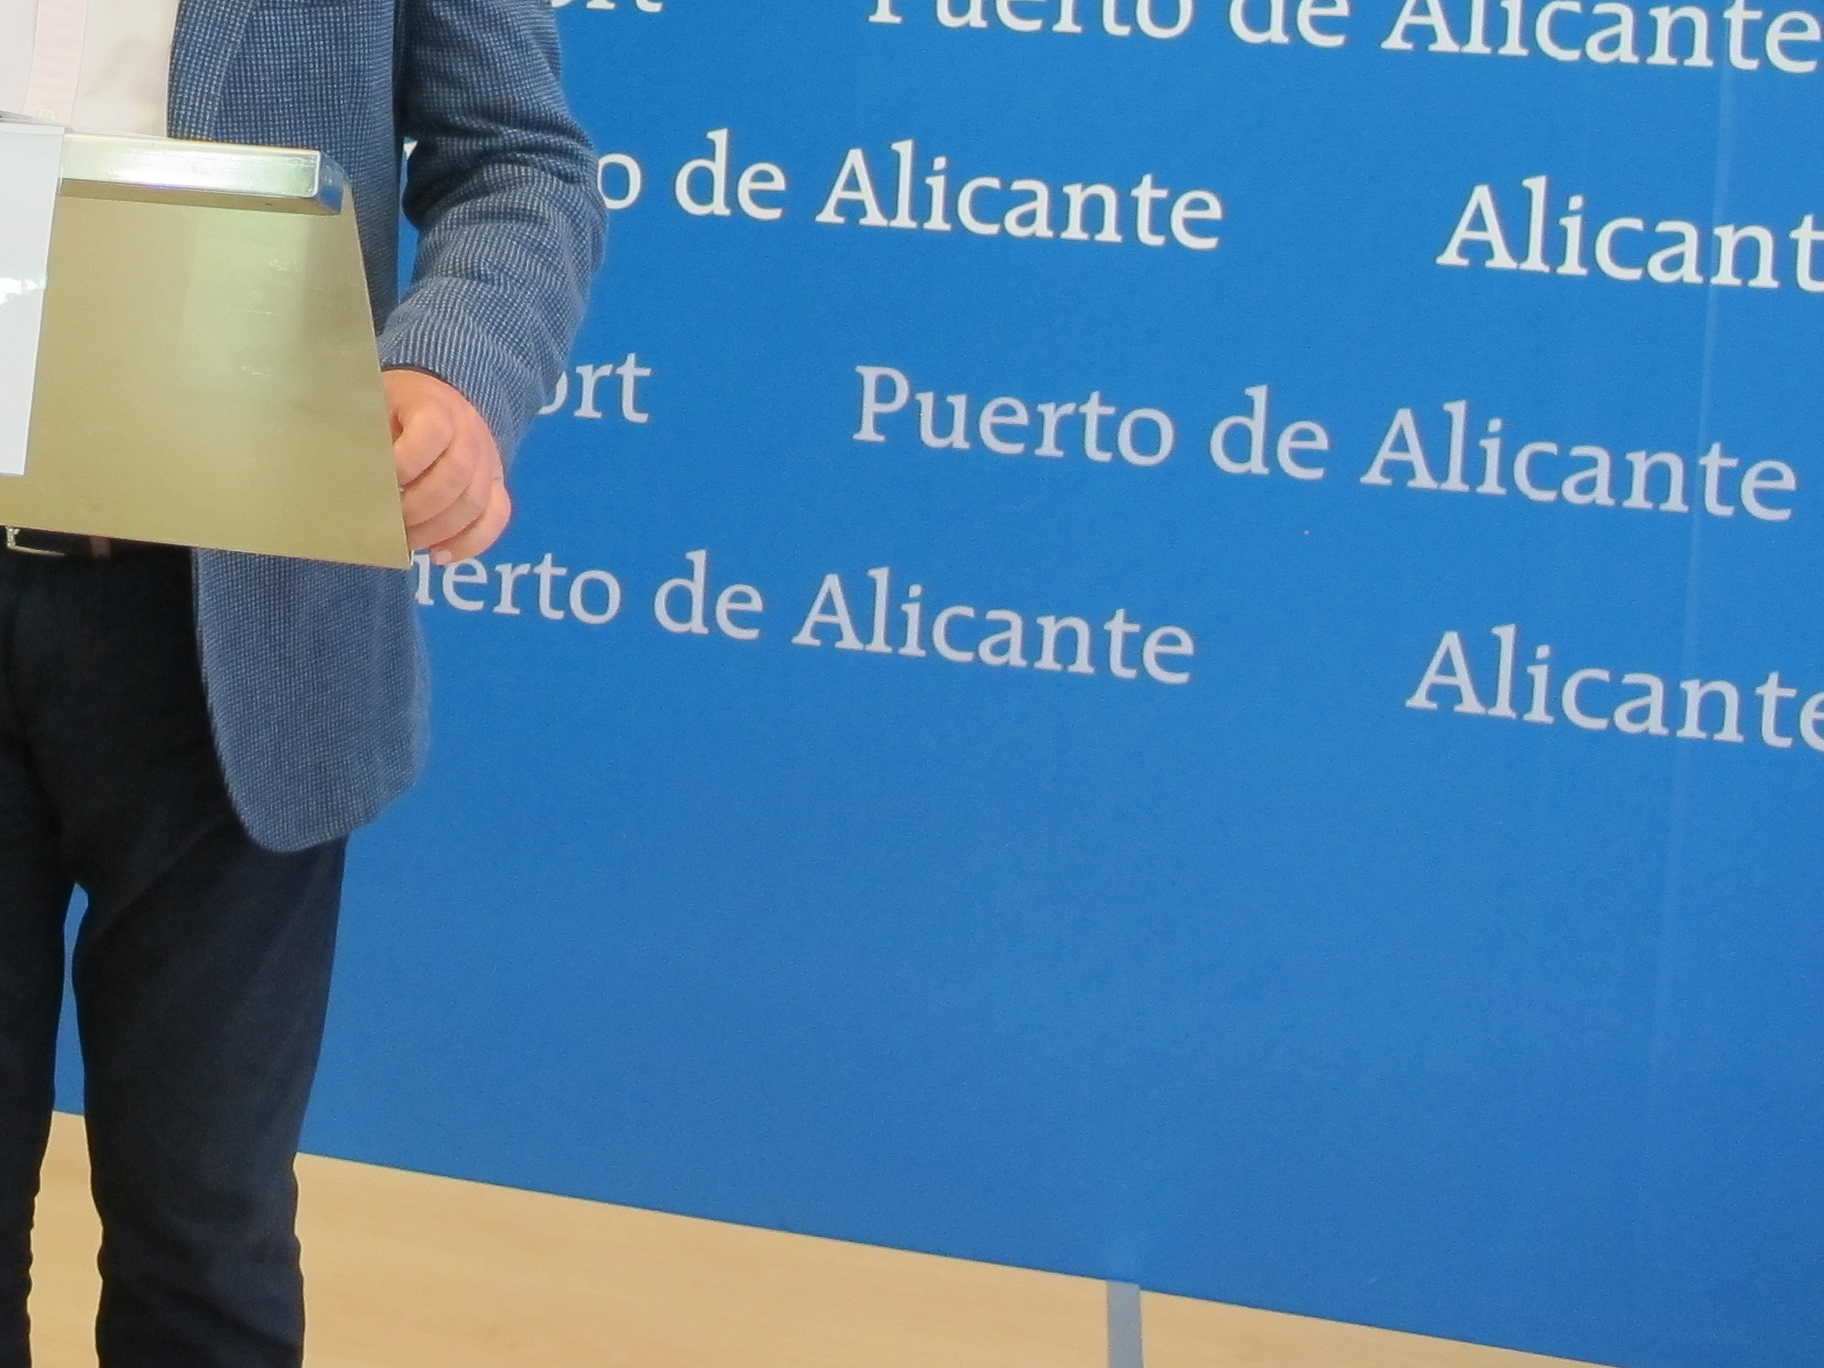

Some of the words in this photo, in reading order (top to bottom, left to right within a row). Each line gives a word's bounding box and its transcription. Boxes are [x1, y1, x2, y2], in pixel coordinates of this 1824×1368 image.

[675, 128, 788, 221] de
[816, 139, 1224, 250] Alicante
[854, 366, 1175, 466] Puerto
[1210, 386, 1330, 480] de
[1361, 400, 1797, 521] Alicante
[655, 550, 764, 640] de
[792, 568, 1194, 684] Alicante
